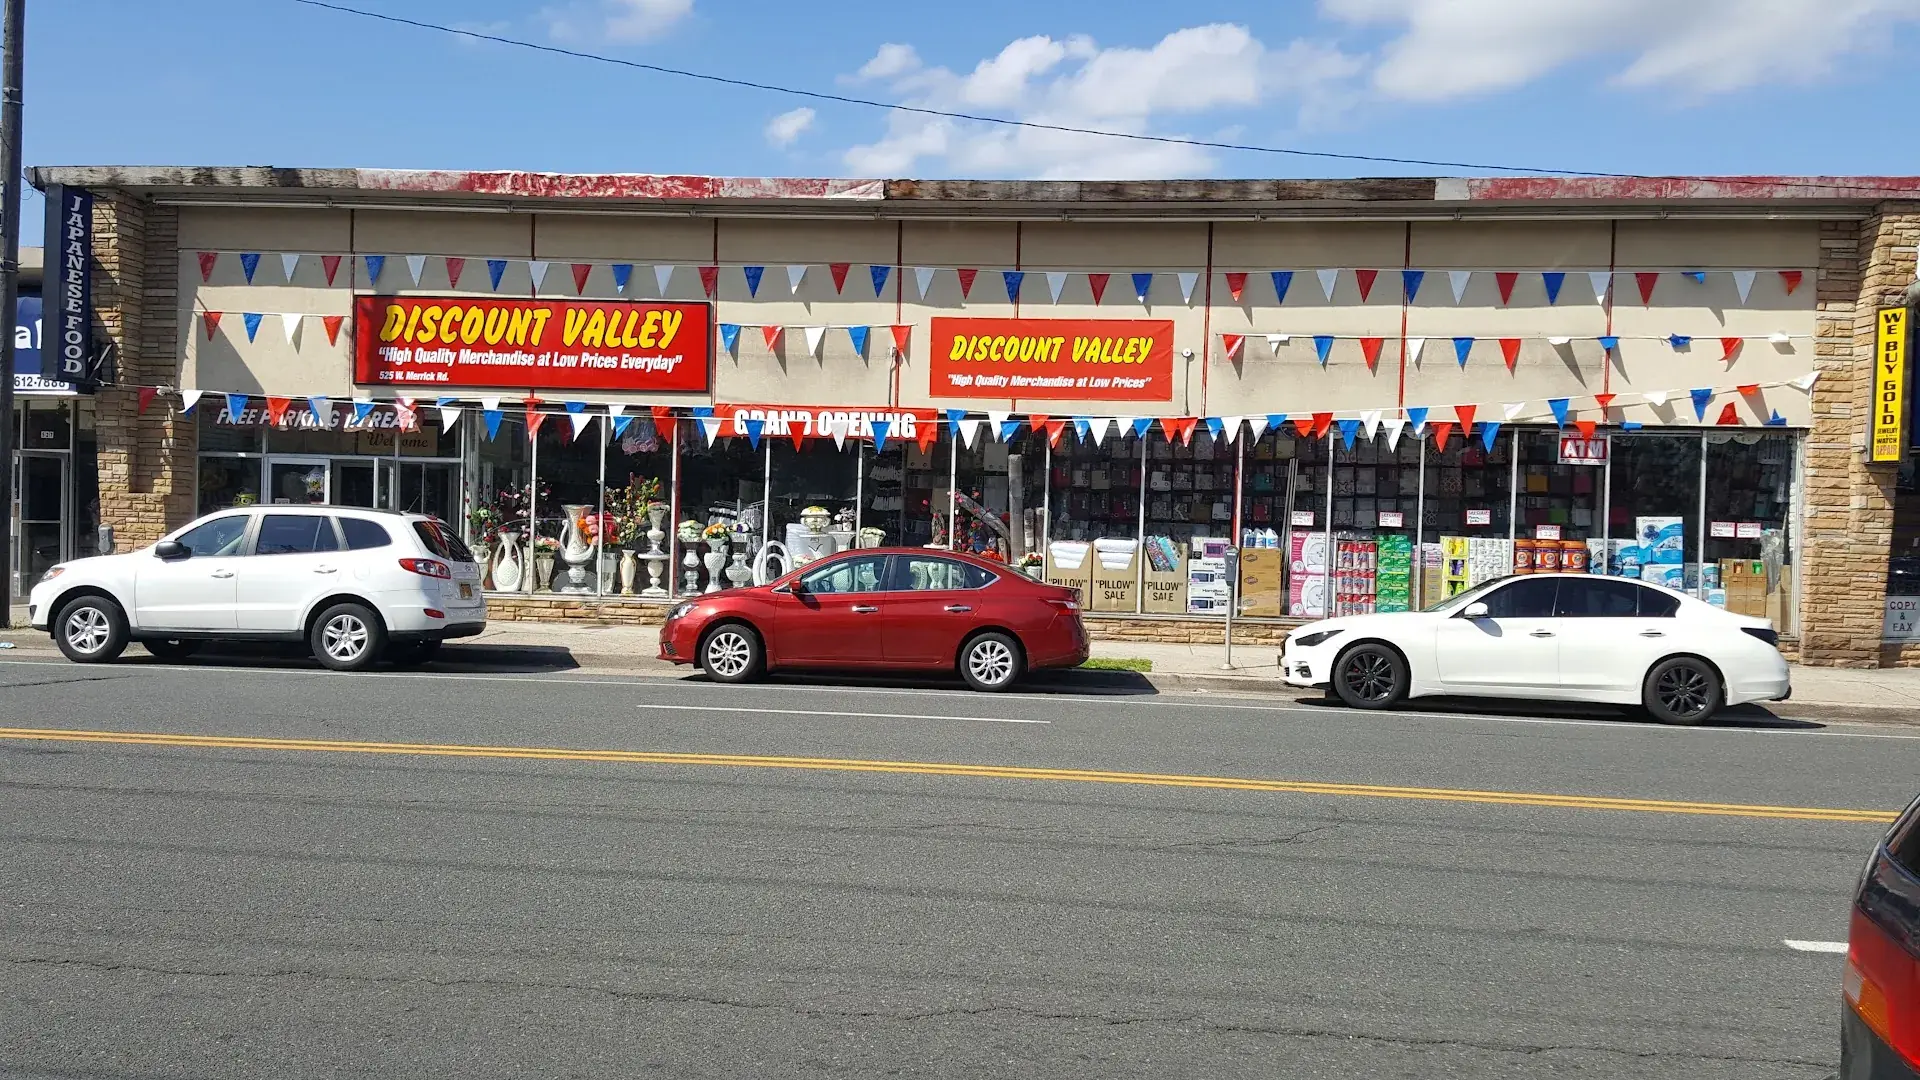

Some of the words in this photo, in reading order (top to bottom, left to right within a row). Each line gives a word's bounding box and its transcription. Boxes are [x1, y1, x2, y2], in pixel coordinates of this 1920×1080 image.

[66, 195, 85, 313] JAPANESE
[380, 304, 552, 347] DISCOUNT
[562, 307, 684, 350] VALLEY
[1883, 312, 1903, 335] WE
[63, 315, 83, 374] FOOD
[949, 334, 1066, 364] DISCOUNT
[1071, 336, 1154, 365] VALLEY
[414, 347, 457, 367] Quality
[458, 348, 535, 367] Merchandise
[536, 352, 551, 367] at
[552, 351, 578, 368] Low
[580, 351, 619, 369] Prices
[1885, 341, 1898, 375] BUY
[379, 371, 394, 380] 525
[395, 371, 404, 380] W.
[405, 371, 436, 381] Merrick
[436, 371, 450, 382] Rd.
[975, 374, 1009, 388] Quality
[1010, 375, 1075, 388] Merchandise
[1075, 376, 1088, 388] at
[1088, 376, 1111, 388] Low
[1882, 380, 1897, 425] GOLD
[367, 432, 428, 448] Welome
[1562, 440, 1603, 458] ATM
[1095, 580, 1135, 590] "PILLOW"
[1143, 581, 1183, 591] "PILLOW"
[1104, 591, 1126, 600] SALE
[1152, 592, 1174, 602] SALE
[1889, 601, 1917, 610] COPY
[1899, 612, 1906, 620] &
[1892, 622, 1913, 631] FAX
